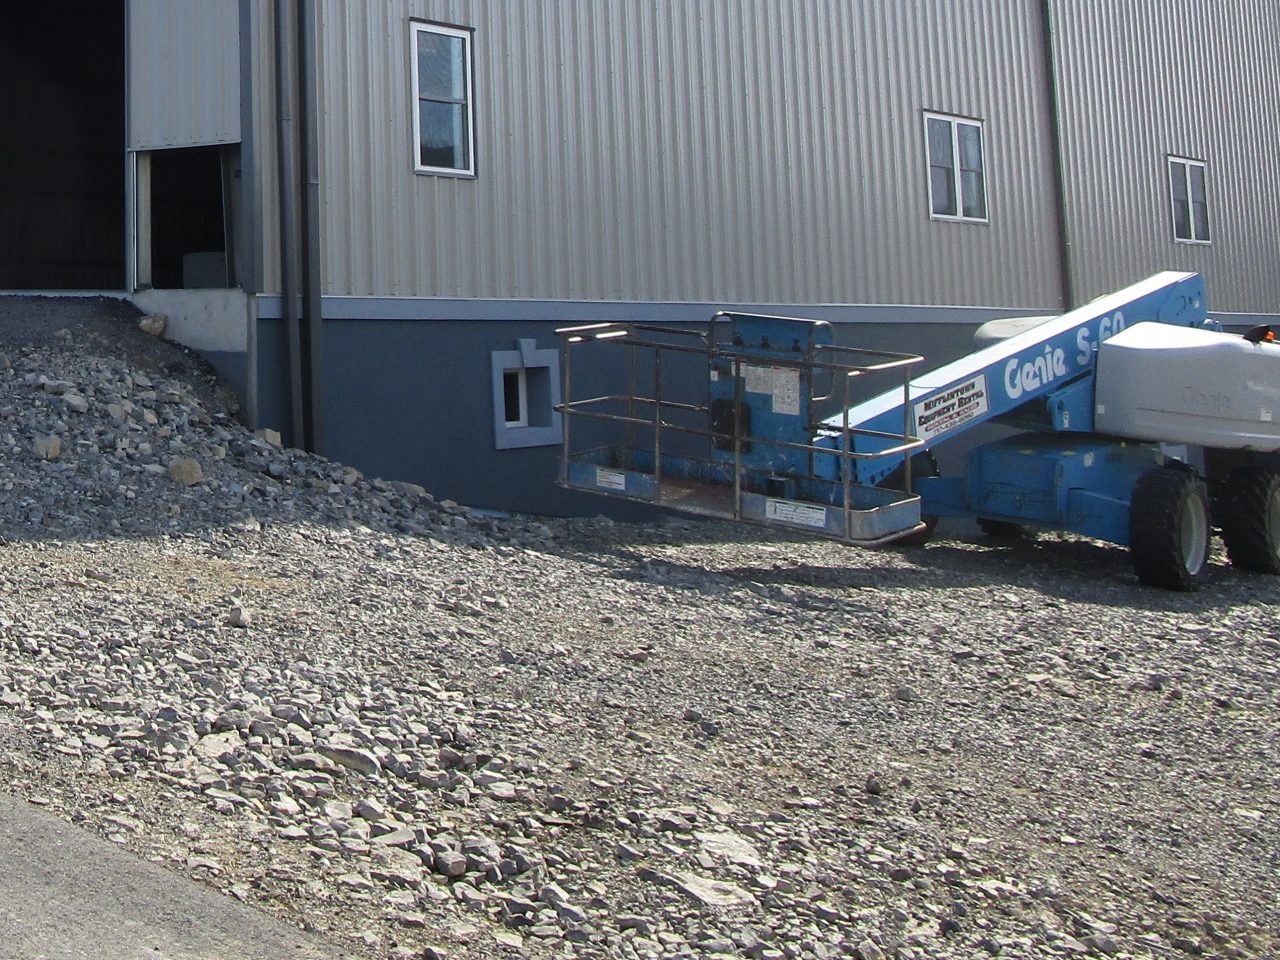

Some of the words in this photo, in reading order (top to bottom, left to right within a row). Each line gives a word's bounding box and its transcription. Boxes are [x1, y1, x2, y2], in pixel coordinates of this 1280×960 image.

[1005, 344, 1066, 399] Genie
[918, 403, 956, 426] EQUIPMENT
[957, 390, 985, 408] RENTAL
